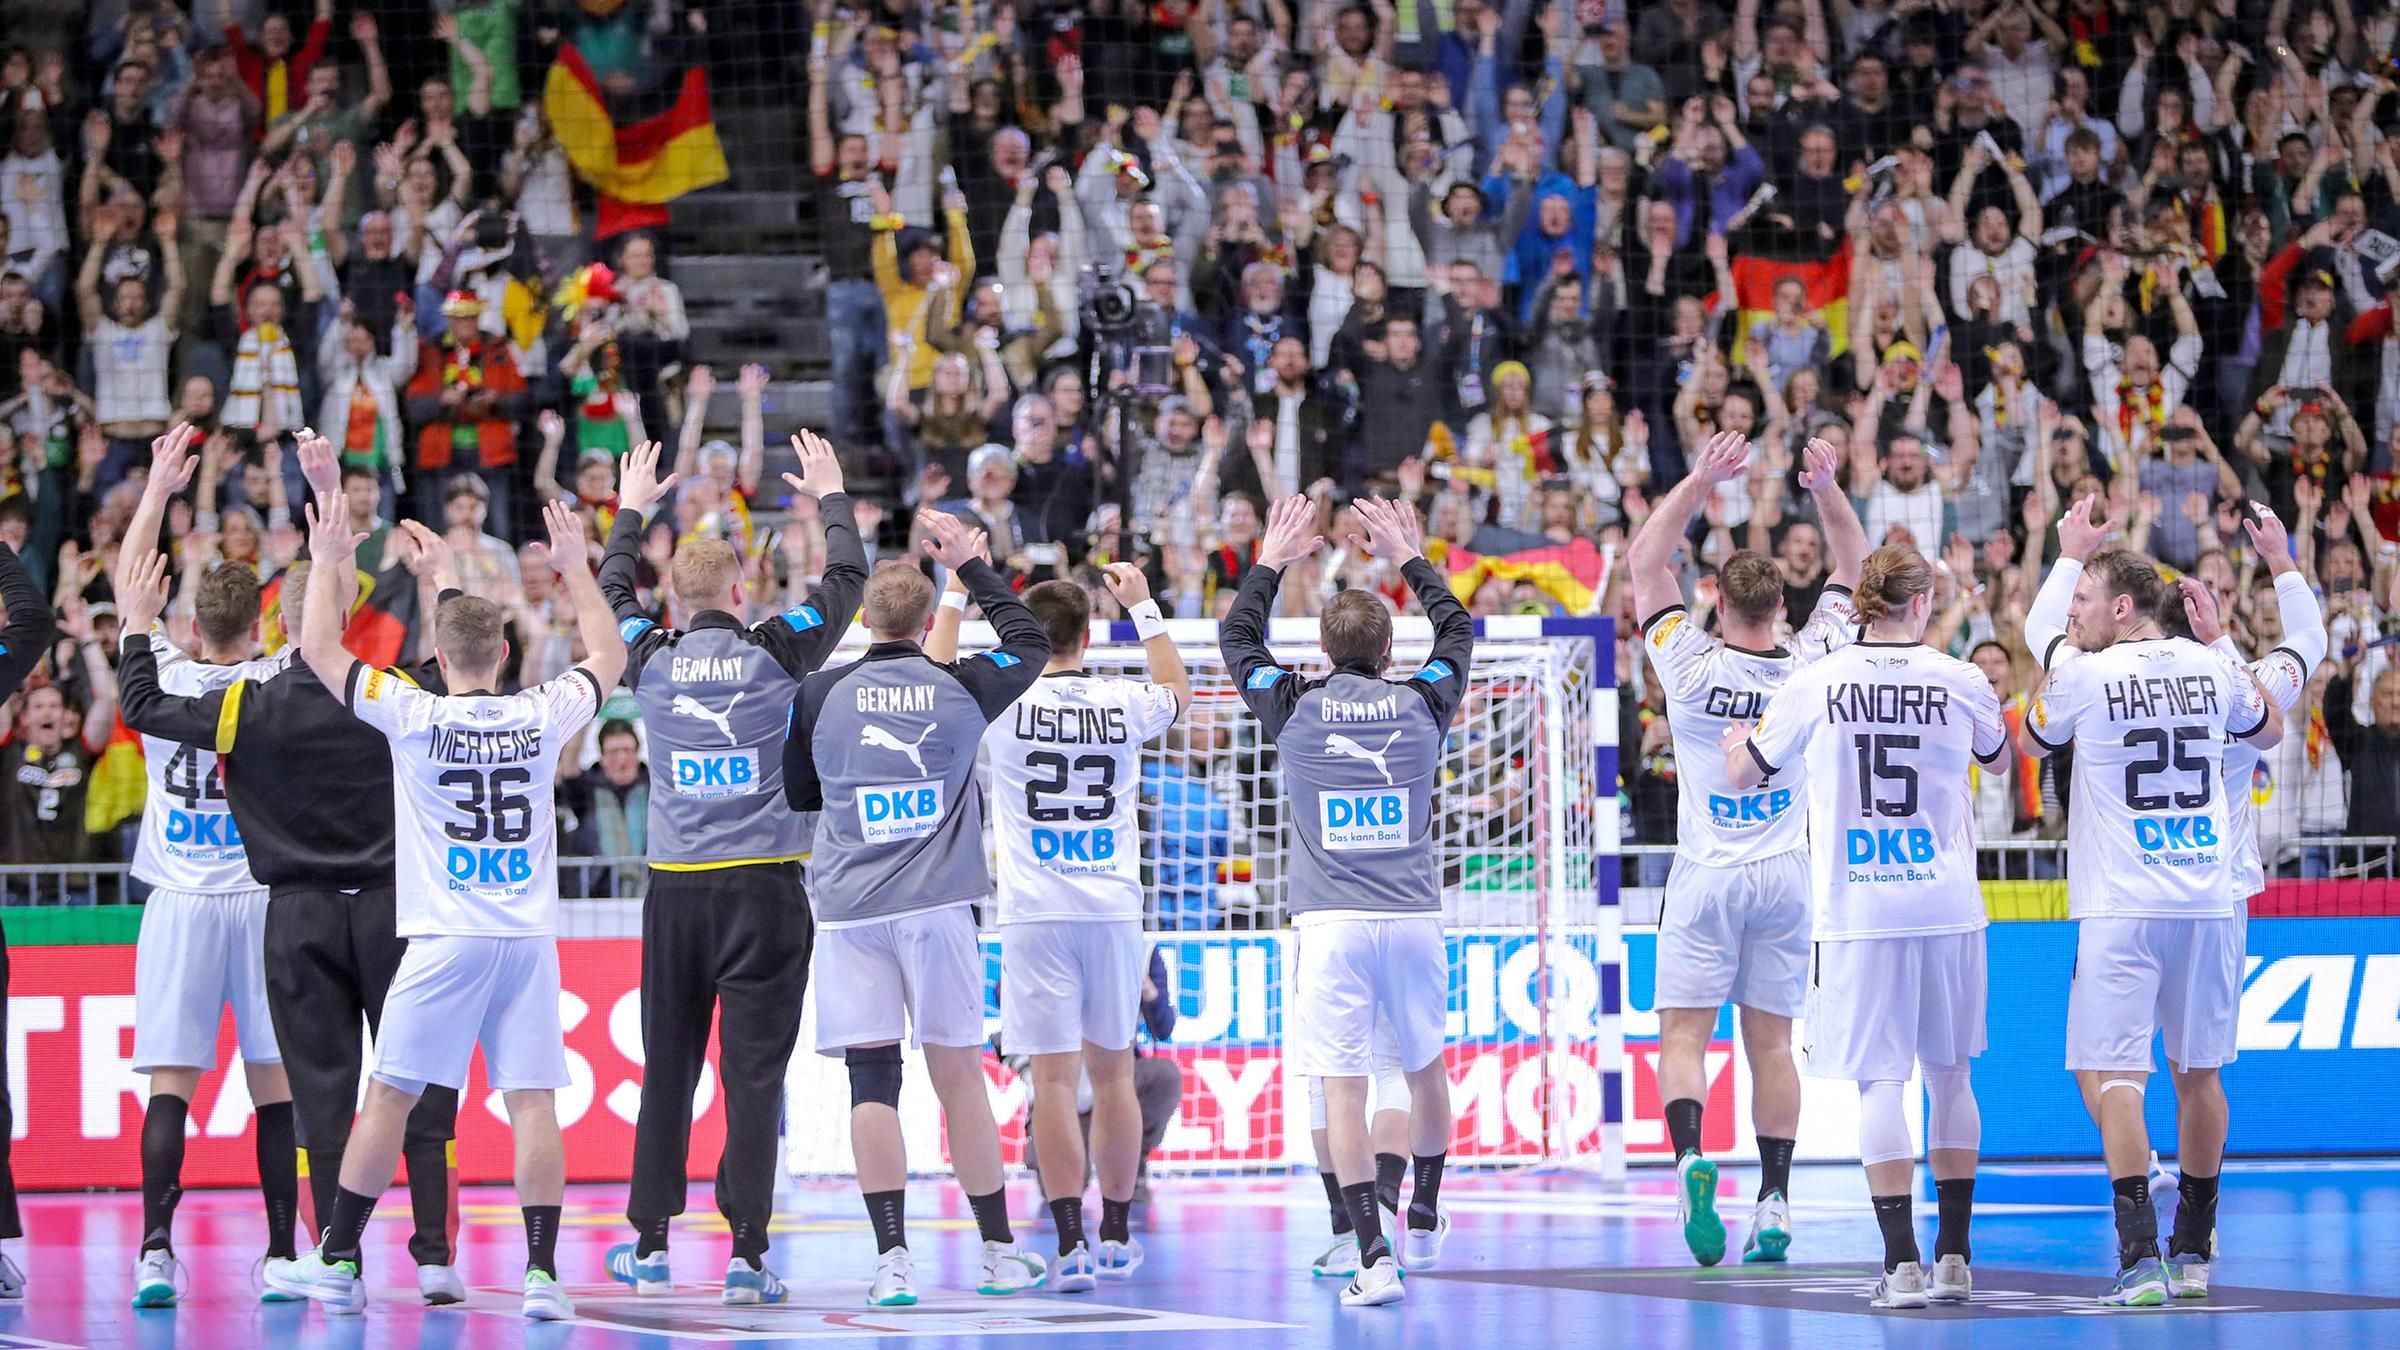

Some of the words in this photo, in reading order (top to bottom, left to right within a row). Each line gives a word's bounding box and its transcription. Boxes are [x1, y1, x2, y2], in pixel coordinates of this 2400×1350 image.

[671, 656, 742, 682] GERMANY
[856, 685, 935, 712] GERMANY
[1321, 695, 1398, 722] GERMANY
[1705, 686, 1766, 720] GOL
[1827, 683, 1949, 725] KNORR
[2104, 674, 2219, 722] HÄFNER
[1015, 702, 1128, 745] USCINS
[428, 724, 541, 764] MERTENS
[678, 756, 752, 786] DKB
[1854, 734, 1921, 818] 15
[2123, 726, 2210, 811] 25
[1025, 751, 1115, 822] 23
[438, 767, 532, 842] 36
[864, 789, 937, 822] DKB
[1327, 795, 1403, 828] DKB
[1709, 789, 1791, 821] DKB
[868, 827, 886, 836] Das
[889, 825, 913, 834] kann
[1031, 828, 1115, 862] DKB
[1329, 832, 1347, 842] Das
[1350, 832, 1374, 842] kann
[1377, 830, 1401, 841] Bank
[1847, 828, 1935, 865] DKB
[2133, 816, 2218, 851] DKB
[447, 846, 532, 883] DKB
[1848, 871, 1870, 883] Das
[1874, 869, 1903, 882] kann
[1907, 868, 1937, 882] Bank
[2165, 855, 2195, 867] kann
[449, 879, 471, 892] Das
